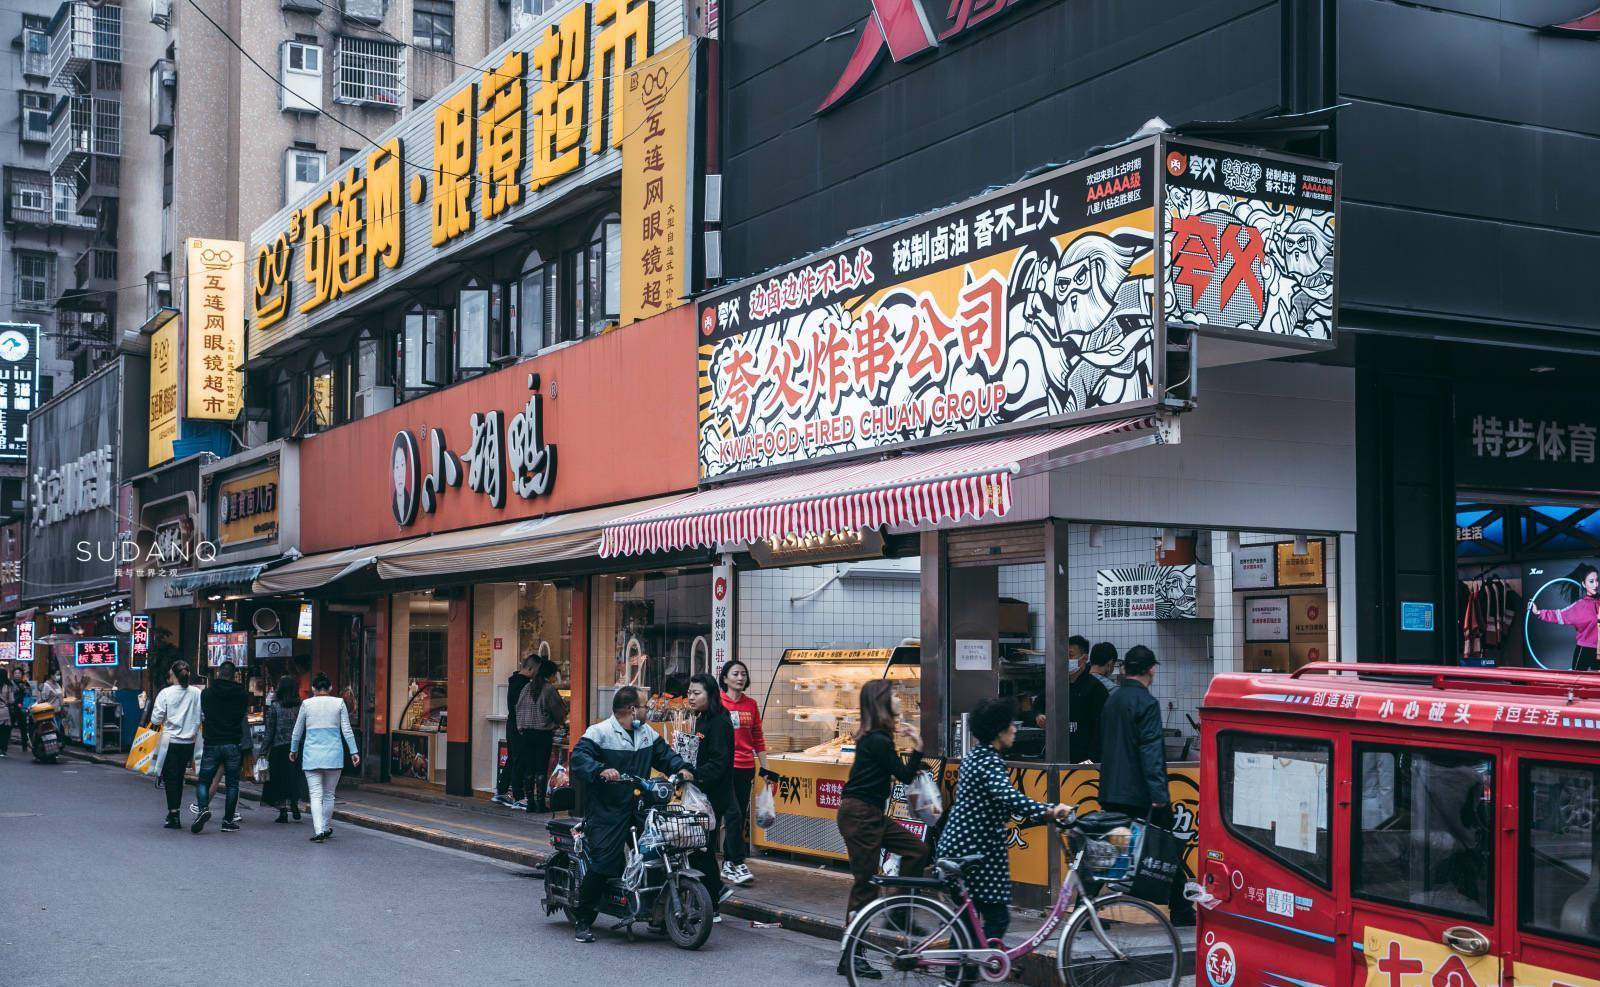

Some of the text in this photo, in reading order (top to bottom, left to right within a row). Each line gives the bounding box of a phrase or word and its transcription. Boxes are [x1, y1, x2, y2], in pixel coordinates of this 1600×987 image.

[1086, 157, 1142, 186] 欢迎来到上古时期
[1086, 170, 1141, 203] AAAAA级
[748, 246, 875, 321] 边卤边炸不上火
[892, 217, 970, 277] 秘制卤油
[972, 187, 1061, 248] 香不上火
[203, 275, 226, 414] 互连网眼镜超市
[718, 275, 1004, 427] 夸父炸串公司
[718, 382, 1008, 466] KWAFOOD FIRED CHUAN GROUP
[1473, 415, 1598, 464] 特步体育
[1311, 691, 1361, 709] 创造绿
[1377, 698, 1472, 725] 小心碰头
